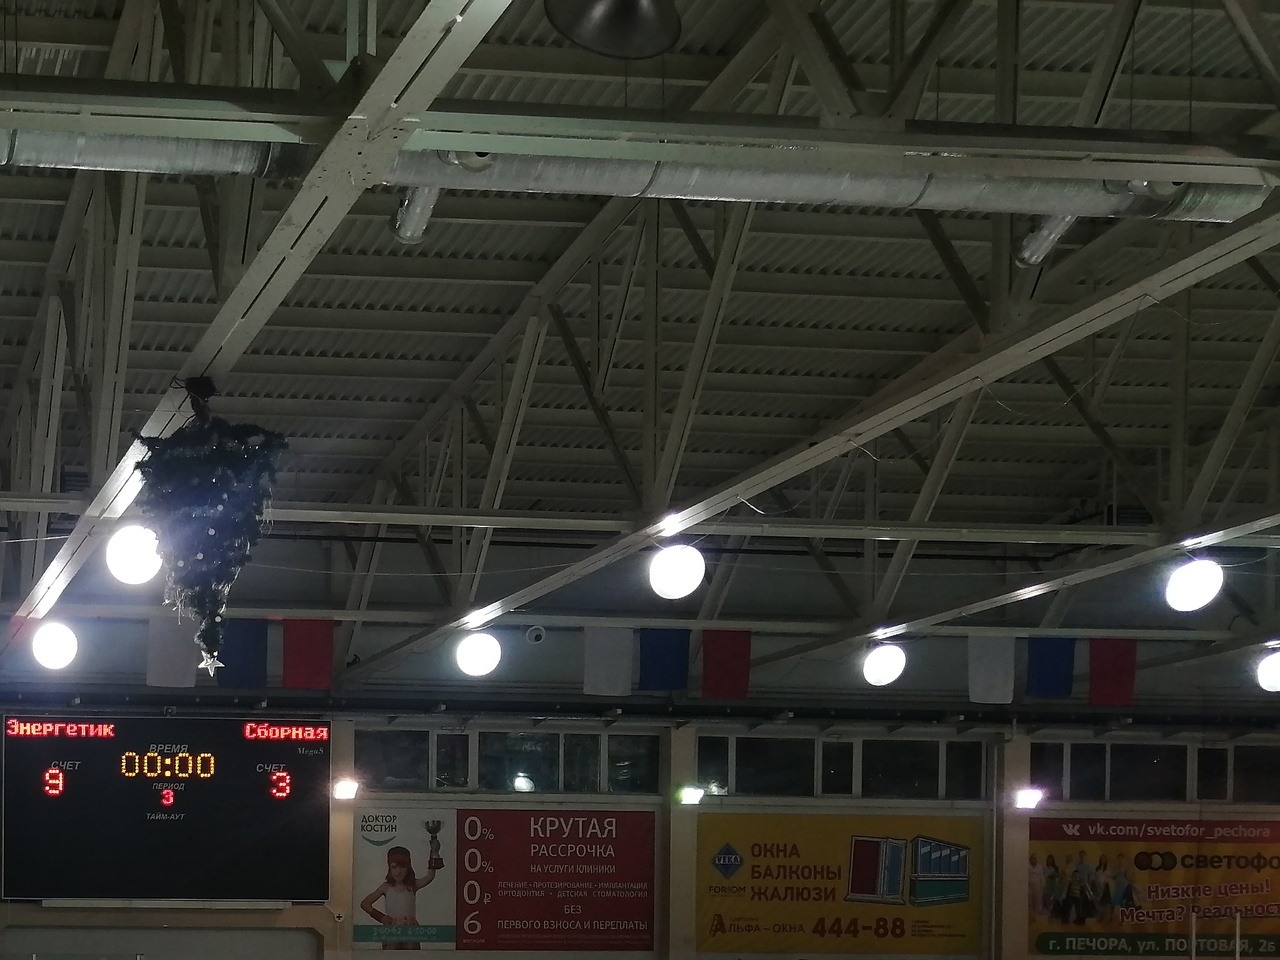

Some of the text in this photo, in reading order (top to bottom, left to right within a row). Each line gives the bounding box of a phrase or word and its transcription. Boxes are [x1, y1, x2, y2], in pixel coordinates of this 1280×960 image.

[6, 718, 116, 738] Энергетик
[243, 722, 329, 740] Сборная
[149, 743, 189, 753] ВРЕМЯ
[50, 760, 82, 771] СЧЕТ
[120, 751, 216, 778] 00:00
[255, 762, 286, 773] СЧЕТ
[43, 768, 65, 796] 9
[152, 782, 186, 792] ПЕРИОД
[269, 771, 292, 798] 3
[160, 789, 175, 806] 3
[146, 811, 186, 821] ТАЙМ-АУТ
[361, 814, 398, 824] ДОКТОР
[360, 824, 398, 833] КОСТИН
[464, 815, 495, 841] 0%
[530, 816, 617, 839] КРУТАЯ
[1088, 823, 1271, 840] vk.com/svetofor_pechora
[530, 843, 616, 858] РАССРОЧКА
[750, 843, 801, 859] ОКНА
[464, 847, 495, 873] 0%
[530, 865, 616, 874] НА УСЛУГИ КЛИНИКИ
[750, 865, 842, 880] БАЛКОНЫ
[498, 881, 648, 890] ЛЕЧЕНИЕ ПРОТЕЗИРОВАНИЕ ИМПЛАНТАЦИЯ
[1147, 877, 1271, 900] Низкие цены!
[498, 890, 648, 899] ОРТОДОНТИЯ ДЕТСКАЯ СТОМАТОЛОГИЯ
[750, 886, 837, 902] ЖАЛЮЗИ
[563, 904, 582, 915] БЕЗ
[1120, 905, 1185, 923] Мечта?
[463, 910, 482, 935] 6
[497, 919, 649, 931] ПЕРВОГО ВЗНОСА И ПЕРЕПЛАТЫ
[772, 923, 805, 933] ОКНА
[811, 917, 906, 938] 444-88
[1065, 938, 1133, 954] ПЕЧОРА,
[1137, 940, 1160, 954] ул.
